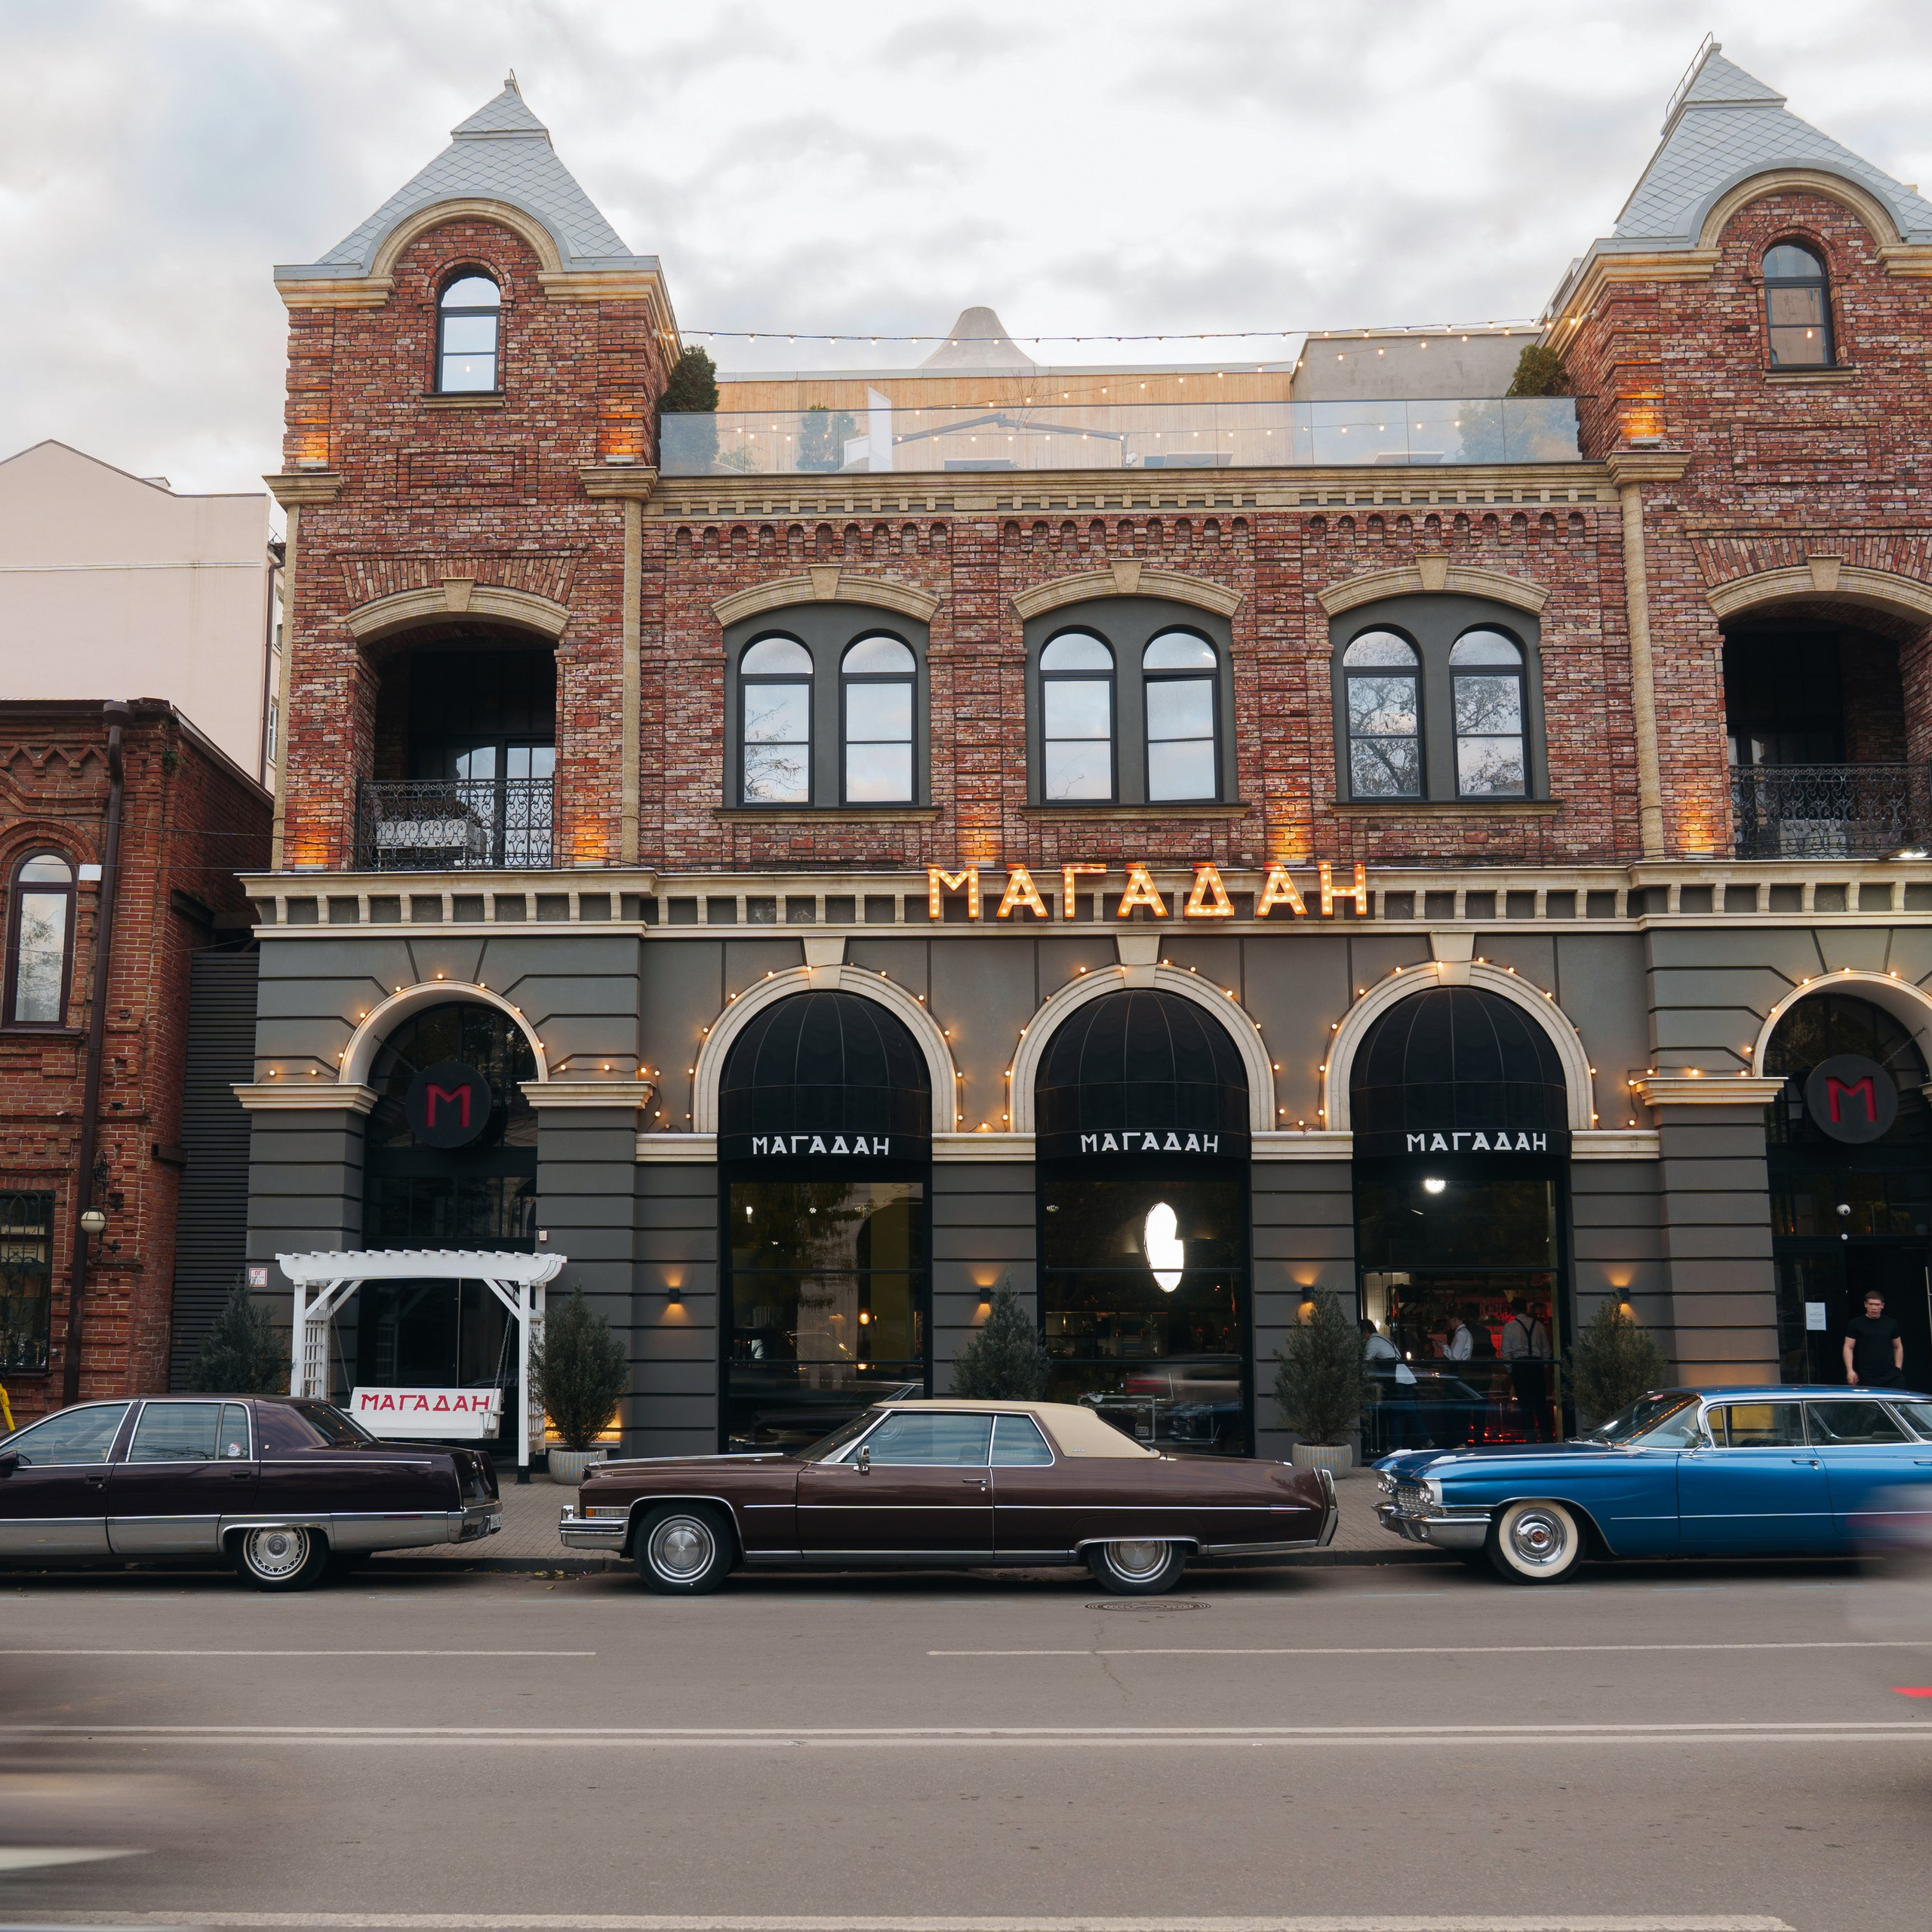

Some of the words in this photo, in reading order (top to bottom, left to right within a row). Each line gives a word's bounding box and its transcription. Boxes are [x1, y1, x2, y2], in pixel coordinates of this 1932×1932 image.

[927, 861, 1367, 918] МАГАДАН
[426, 1082, 471, 1128] М
[1825, 1076, 1877, 1122] М
[752, 1136, 889, 1155] МАГАДАН
[1081, 1132, 1219, 1153] МАГАДАН
[1407, 1132, 1546, 1152] МАГАДАН
[361, 1394, 490, 1411] МАГАДАН
